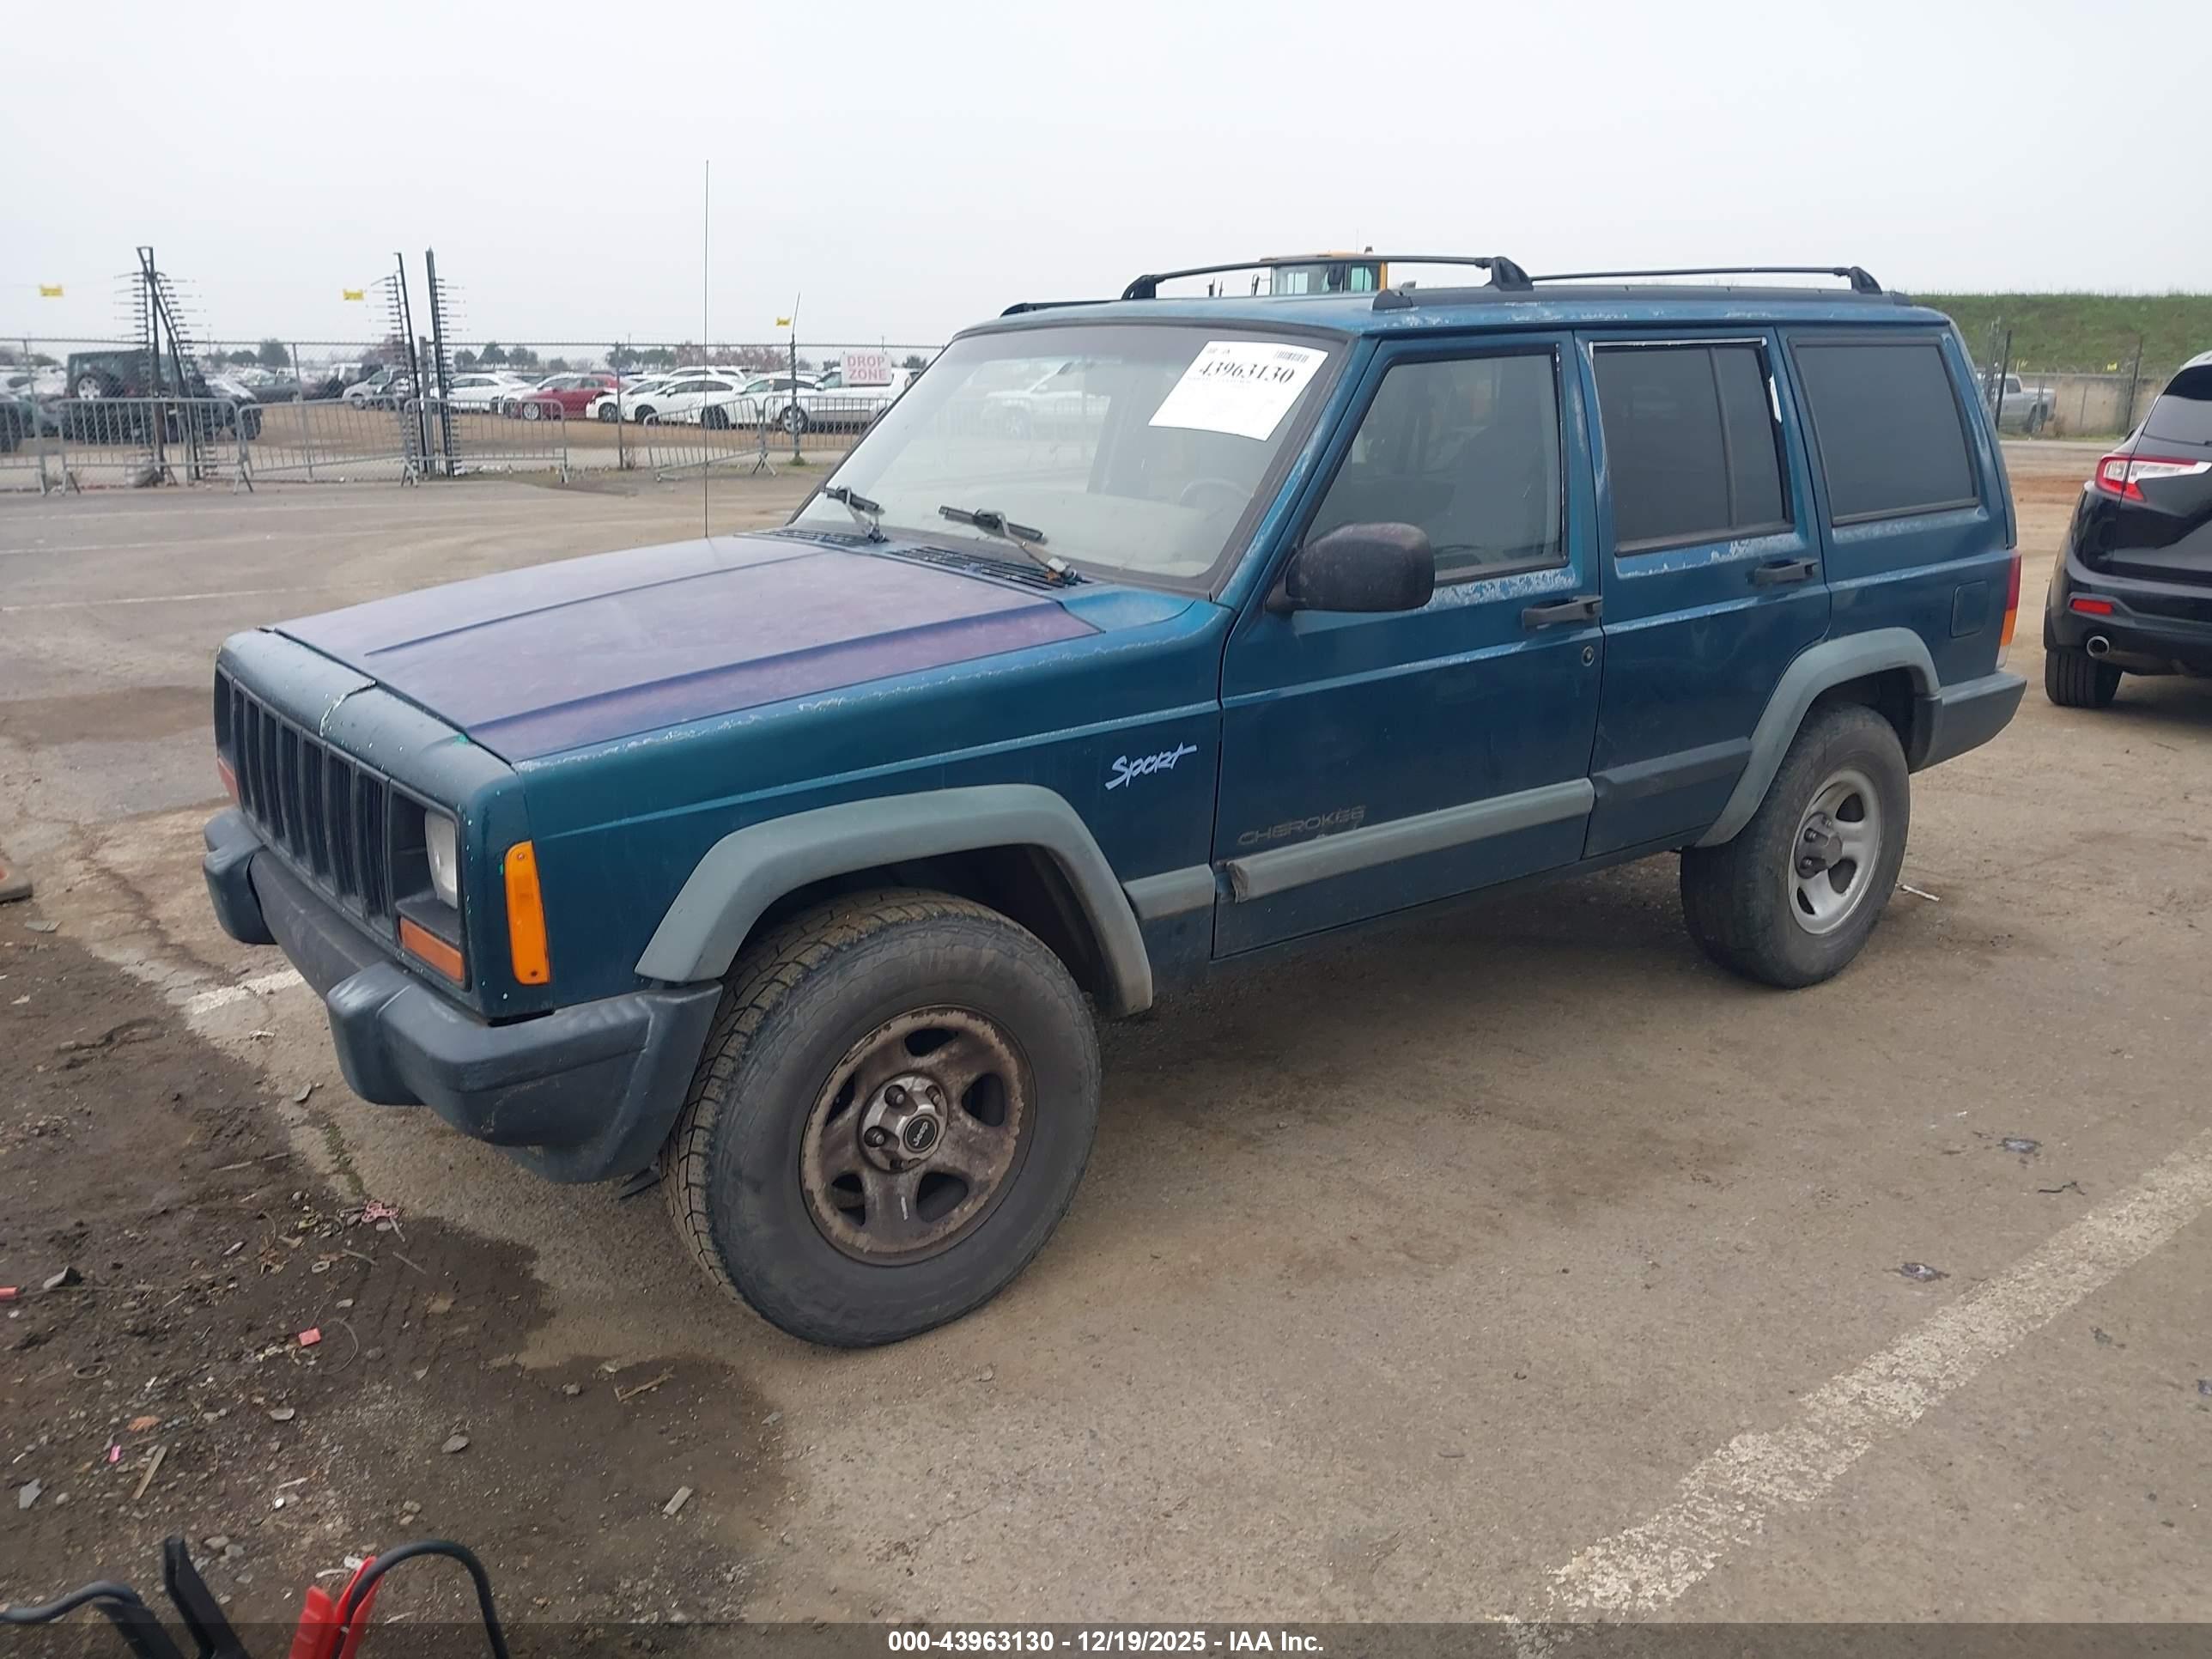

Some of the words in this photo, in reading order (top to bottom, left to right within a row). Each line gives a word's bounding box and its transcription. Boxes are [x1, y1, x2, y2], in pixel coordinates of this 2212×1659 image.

[848, 356, 885, 368] DROP
[1200, 361, 1295, 384] 43963130
[848, 368, 887, 380] ZONE
[1104, 742, 1197, 790] Sport
[1237, 805, 1366, 846] CHEROKEE
